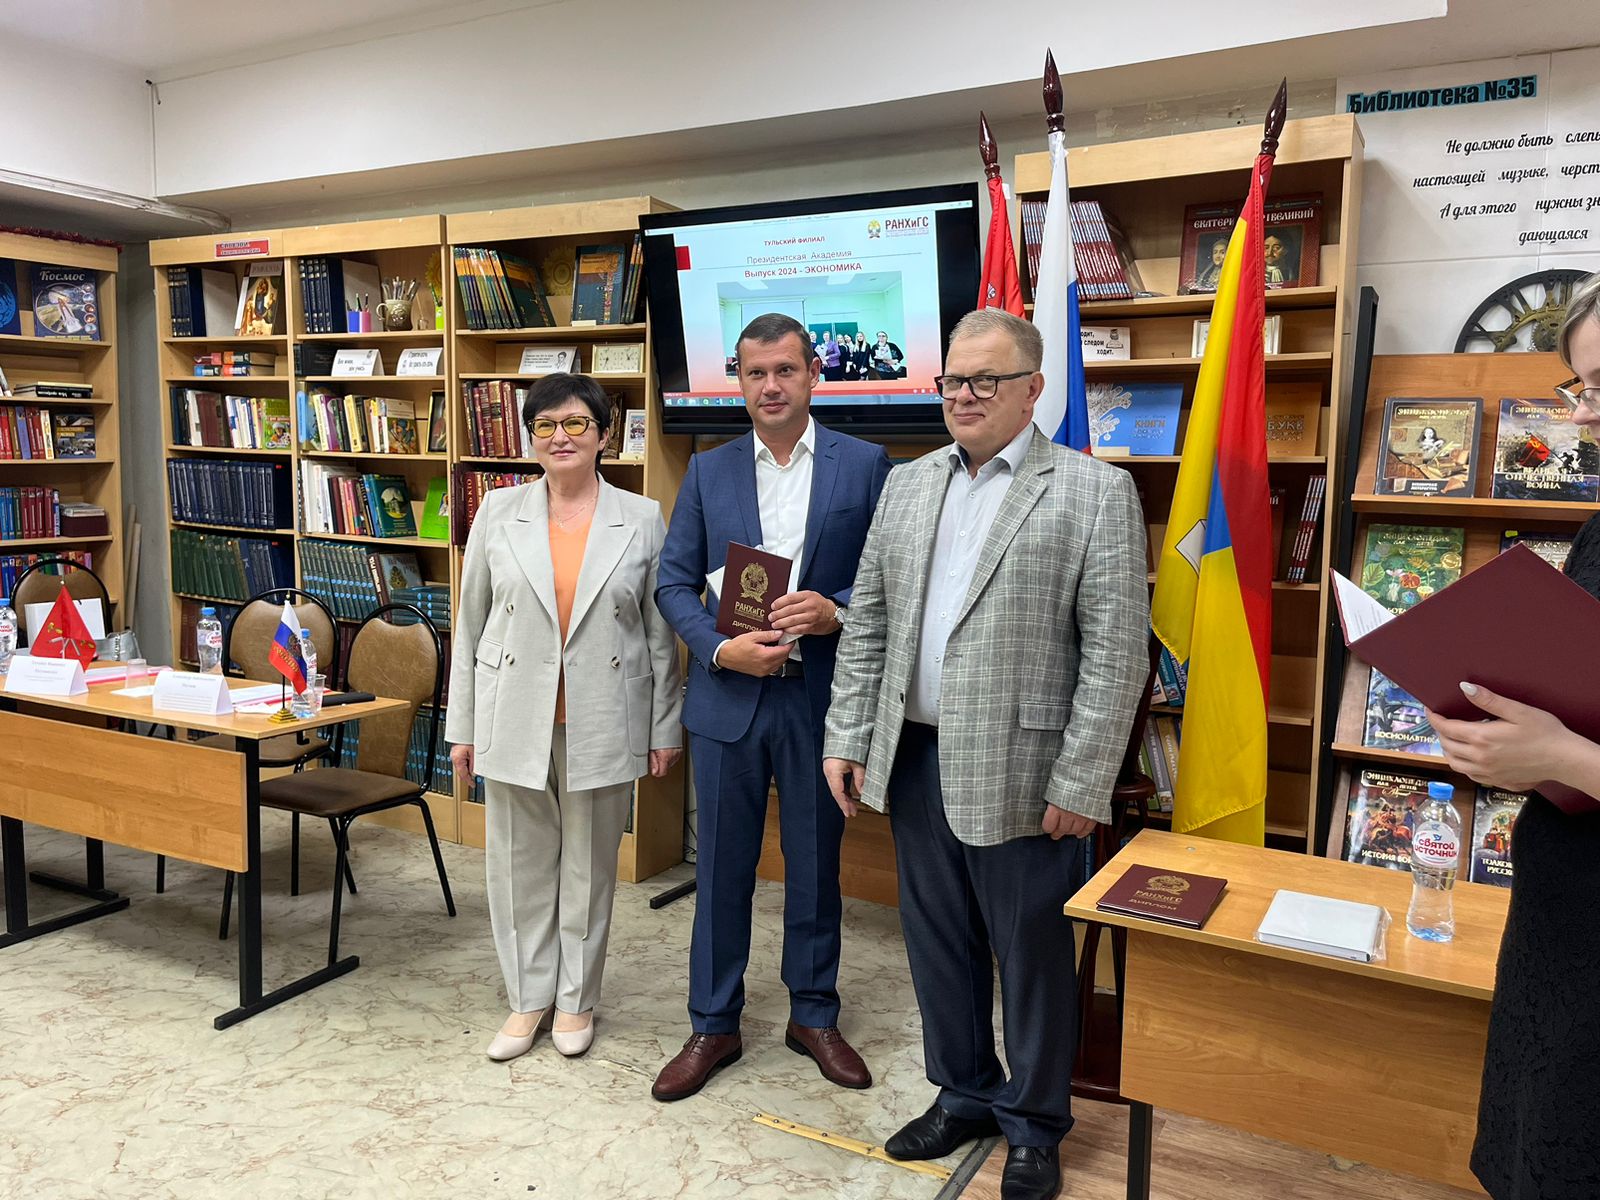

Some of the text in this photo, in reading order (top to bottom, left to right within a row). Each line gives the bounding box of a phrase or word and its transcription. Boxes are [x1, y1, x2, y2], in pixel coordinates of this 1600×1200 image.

[1350, 75, 1536, 113] Библиотека №35
[1446, 139, 1463, 154] Не
[1464, 138, 1515, 155] должно
[1517, 133, 1554, 148] быть
[1413, 170, 1486, 188] настоящей
[1498, 166, 1549, 185] музыке,
[1270, 207, 1314, 222] ВЕЛИКИЙ
[1439, 203, 1451, 219] А
[1452, 205, 1477, 221] для
[1478, 201, 1517, 216] этого
[1535, 197, 1583, 214] нужны
[885, 216, 929, 230] РАНХиГС
[764, 235, 826, 247] ТУЛЬСКИЙ ФИЛИАЛ
[1518, 228, 1589, 246] дающаяся
[746, 249, 852, 265] Президентская Академия
[40, 270, 86, 281] Космос
[744, 267, 777, 279] Выпуск
[778, 265, 798, 276] 2024
[804, 262, 862, 274] ЭКОНОМИКА
[734, 601, 765, 618] РАНХиГС
[1418, 838, 1455, 850] СВЯТОЙ
[1361, 849, 1396, 862] ИСТОРИЯ
[1134, 890, 1183, 903] РАНХиГС
[1127, 898, 1177, 911] ДИПЛОМ
